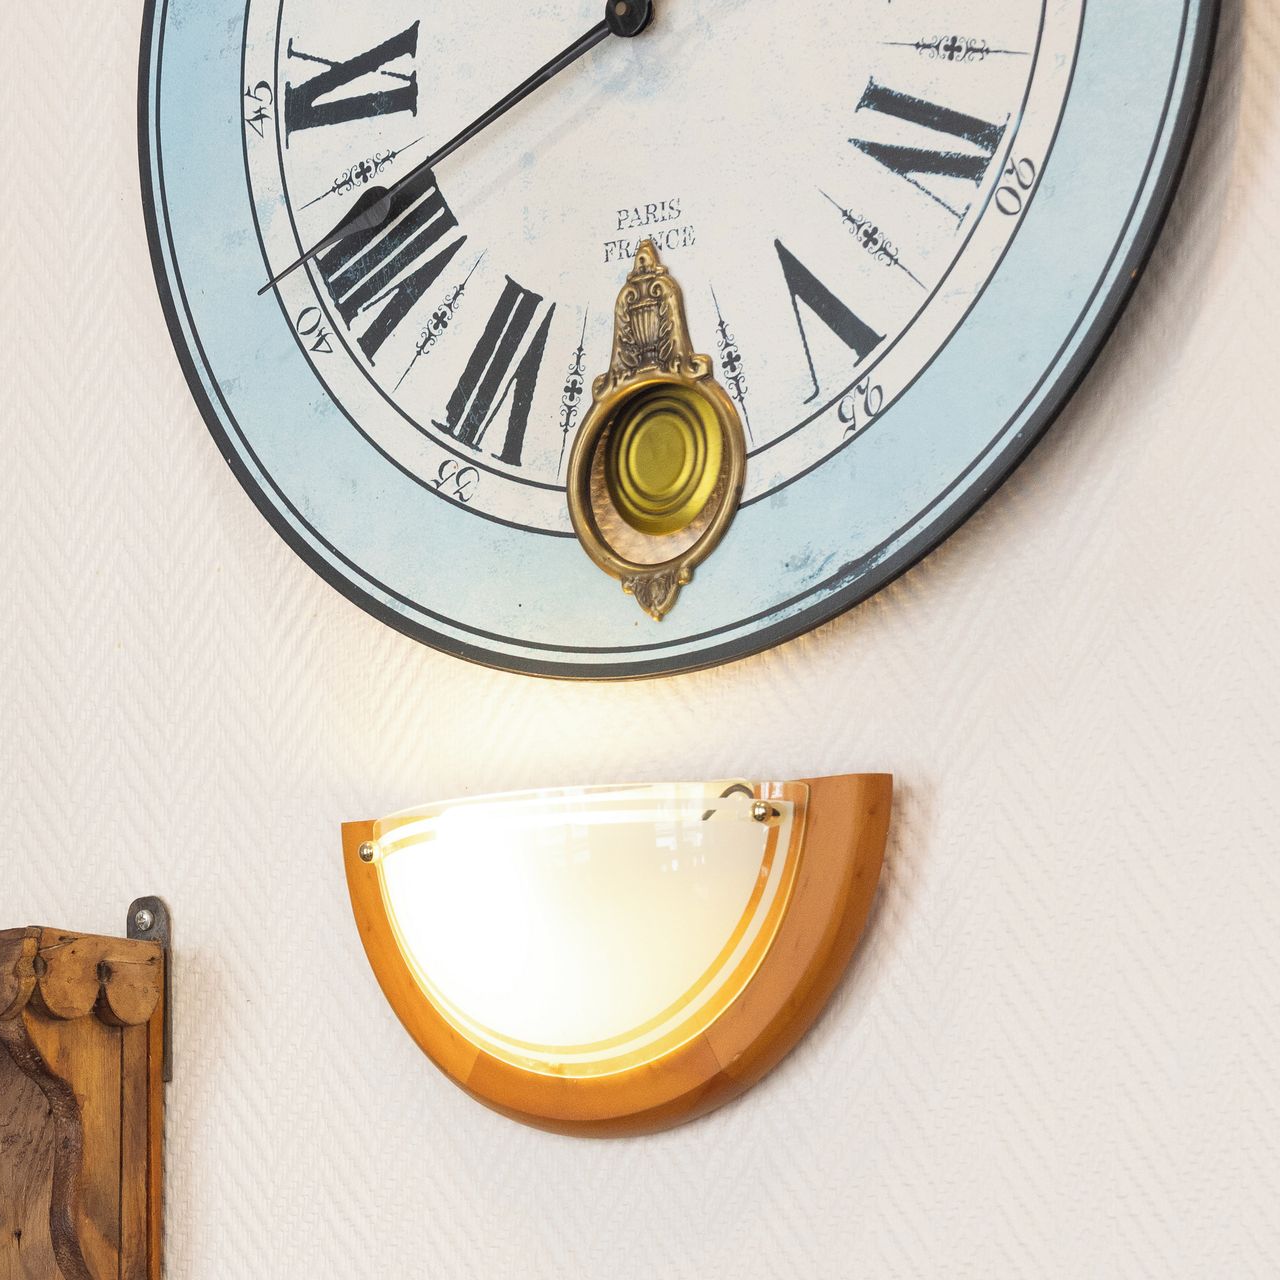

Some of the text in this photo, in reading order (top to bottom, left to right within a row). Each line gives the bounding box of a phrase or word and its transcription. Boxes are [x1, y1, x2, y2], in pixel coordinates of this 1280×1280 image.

[245, 79, 273, 138] 45
[616, 197, 682, 231] PARIS
[774, 237, 887, 405] V
